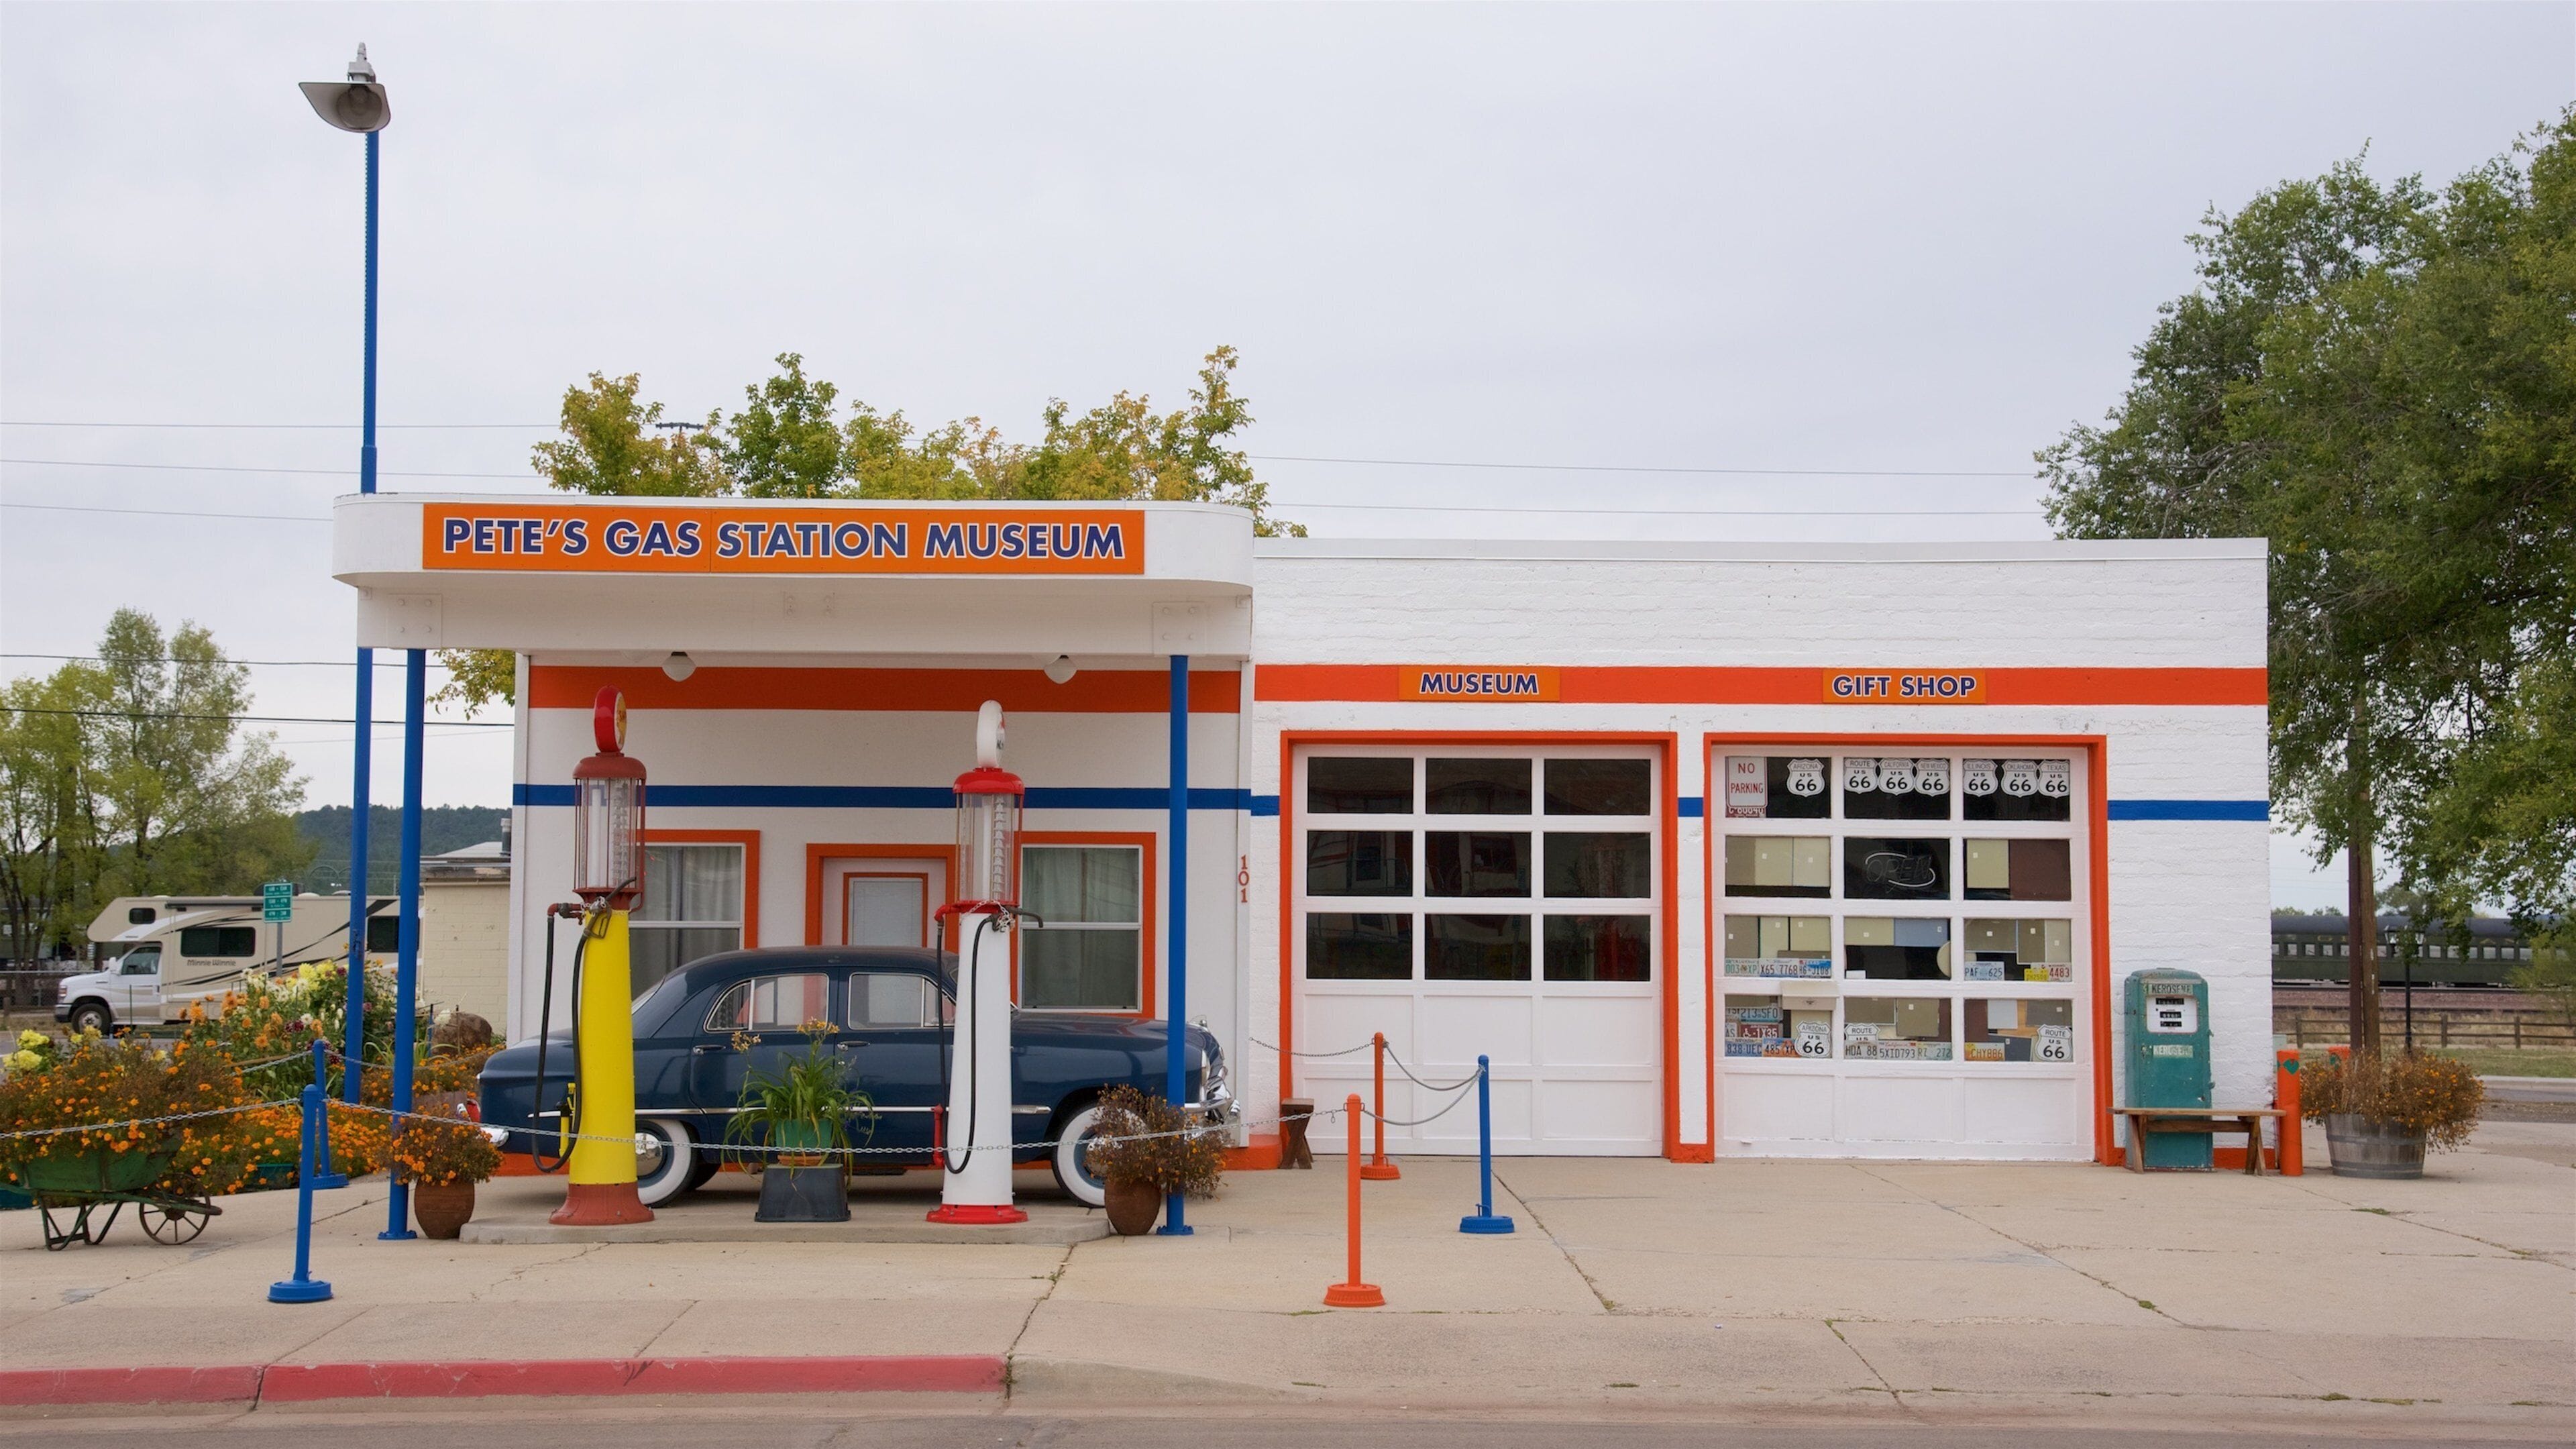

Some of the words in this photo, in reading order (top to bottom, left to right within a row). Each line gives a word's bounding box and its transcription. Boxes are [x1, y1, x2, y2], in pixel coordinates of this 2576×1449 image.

[443, 517, 589, 555] PETE'S
[604, 519, 702, 557] GAS
[716, 521, 908, 559] STATION
[924, 523, 1126, 559] MUSEUM
[1419, 672, 1540, 695] MUSEUM
[1832, 675, 1892, 697] GIFT
[1900, 675, 1977, 698] SHOP
[1738, 763, 1756, 773] NO
[1796, 779, 1817, 791] 66
[1849, 775, 1870, 788] 66
[1886, 777, 1908, 790] 66
[1922, 778, 1943, 791] 66
[1969, 779, 1990, 791] 66
[2010, 779, 2031, 792] 66
[2045, 780, 2068, 792] 66
[1731, 783, 1764, 794] PARKING
[1866, 855, 1933, 883] OPEN
[1238, 854, 1248, 904] 101
[1760, 965, 1774, 975] X65
[1780, 965, 1799, 975] 7768
[1965, 967, 1978, 977] PAF
[1988, 967, 2002, 977] 625
[2049, 967, 2070, 977] 4483
[2151, 984, 2190, 994] KEROSENE
[1803, 1041, 1824, 1054] 66
[2043, 1045, 2065, 1059] 66
